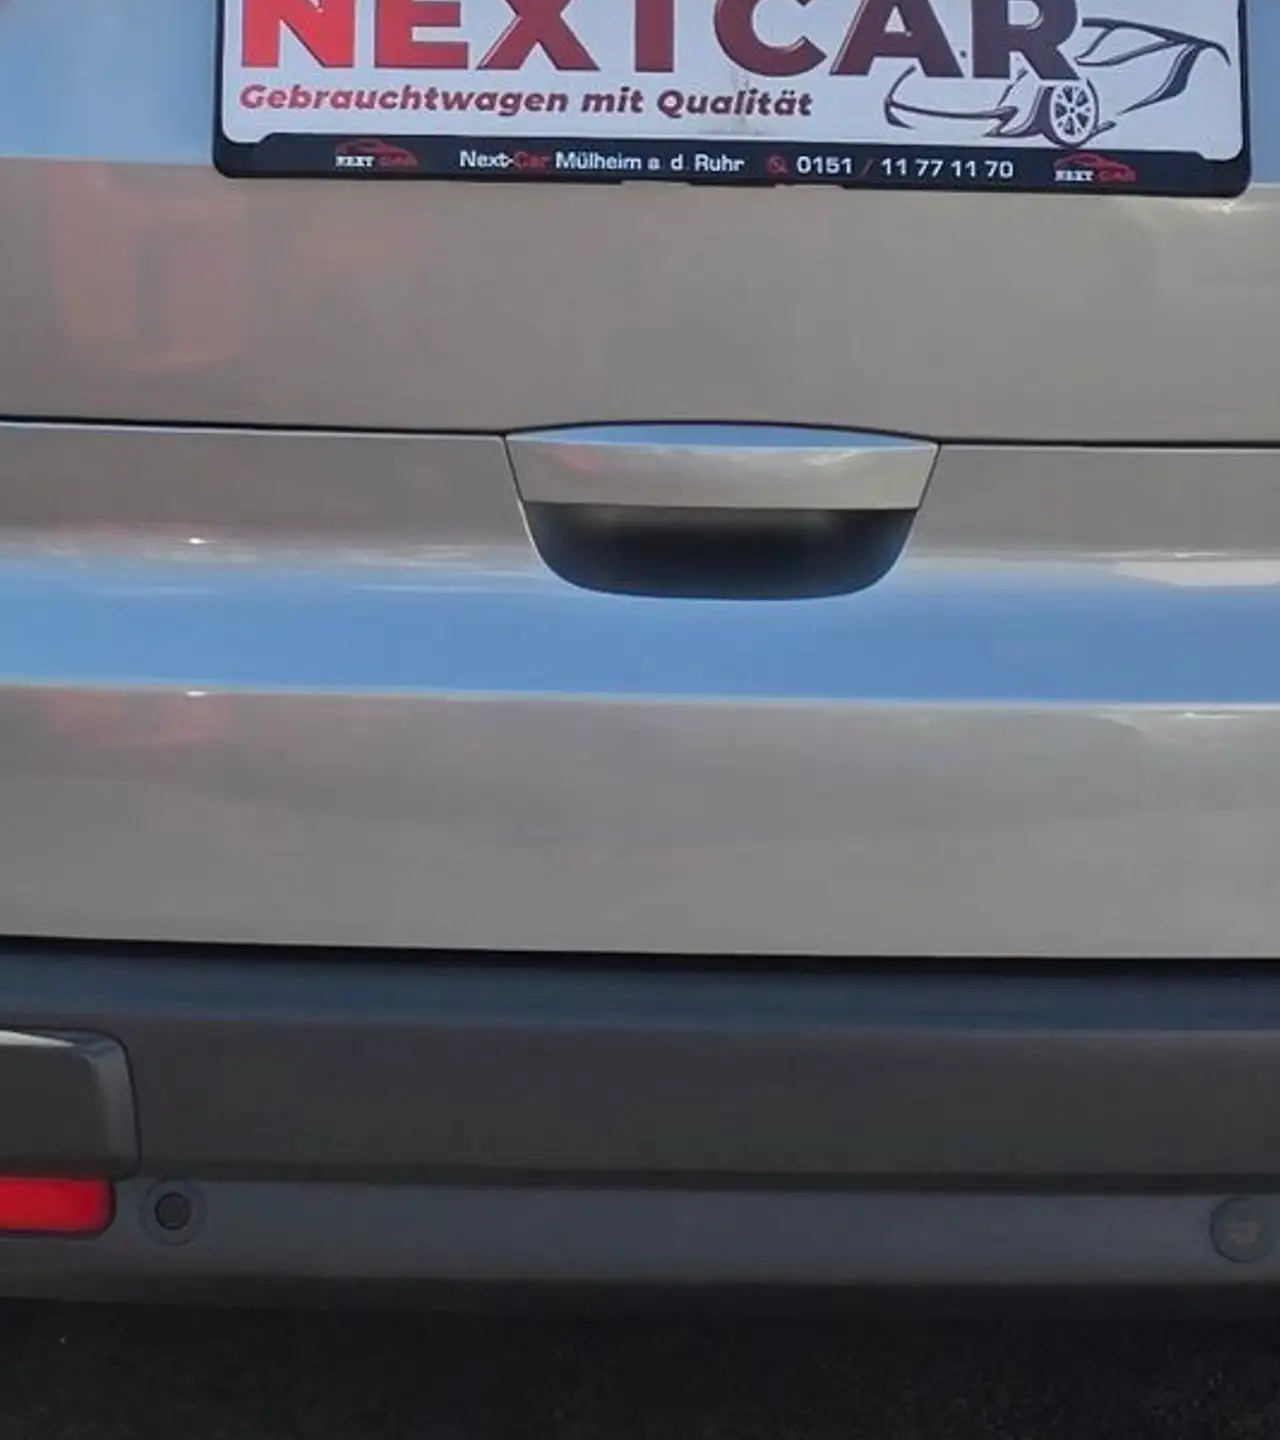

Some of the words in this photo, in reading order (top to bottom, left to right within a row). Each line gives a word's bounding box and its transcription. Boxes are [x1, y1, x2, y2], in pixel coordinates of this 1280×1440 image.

[239, 83, 567, 117] Gebrauchtwagen
[581, 88, 645, 115] mit
[657, 88, 813, 120] Qualität
[555, 150, 641, 170] Mülheim
[695, 153, 745, 172] Ruhr
[796, 155, 853, 175] 0151
[881, 158, 908, 176] 11
[916, 159, 944, 177] 77
[951, 160, 977, 177] 11
[984, 160, 1014, 178] 70
